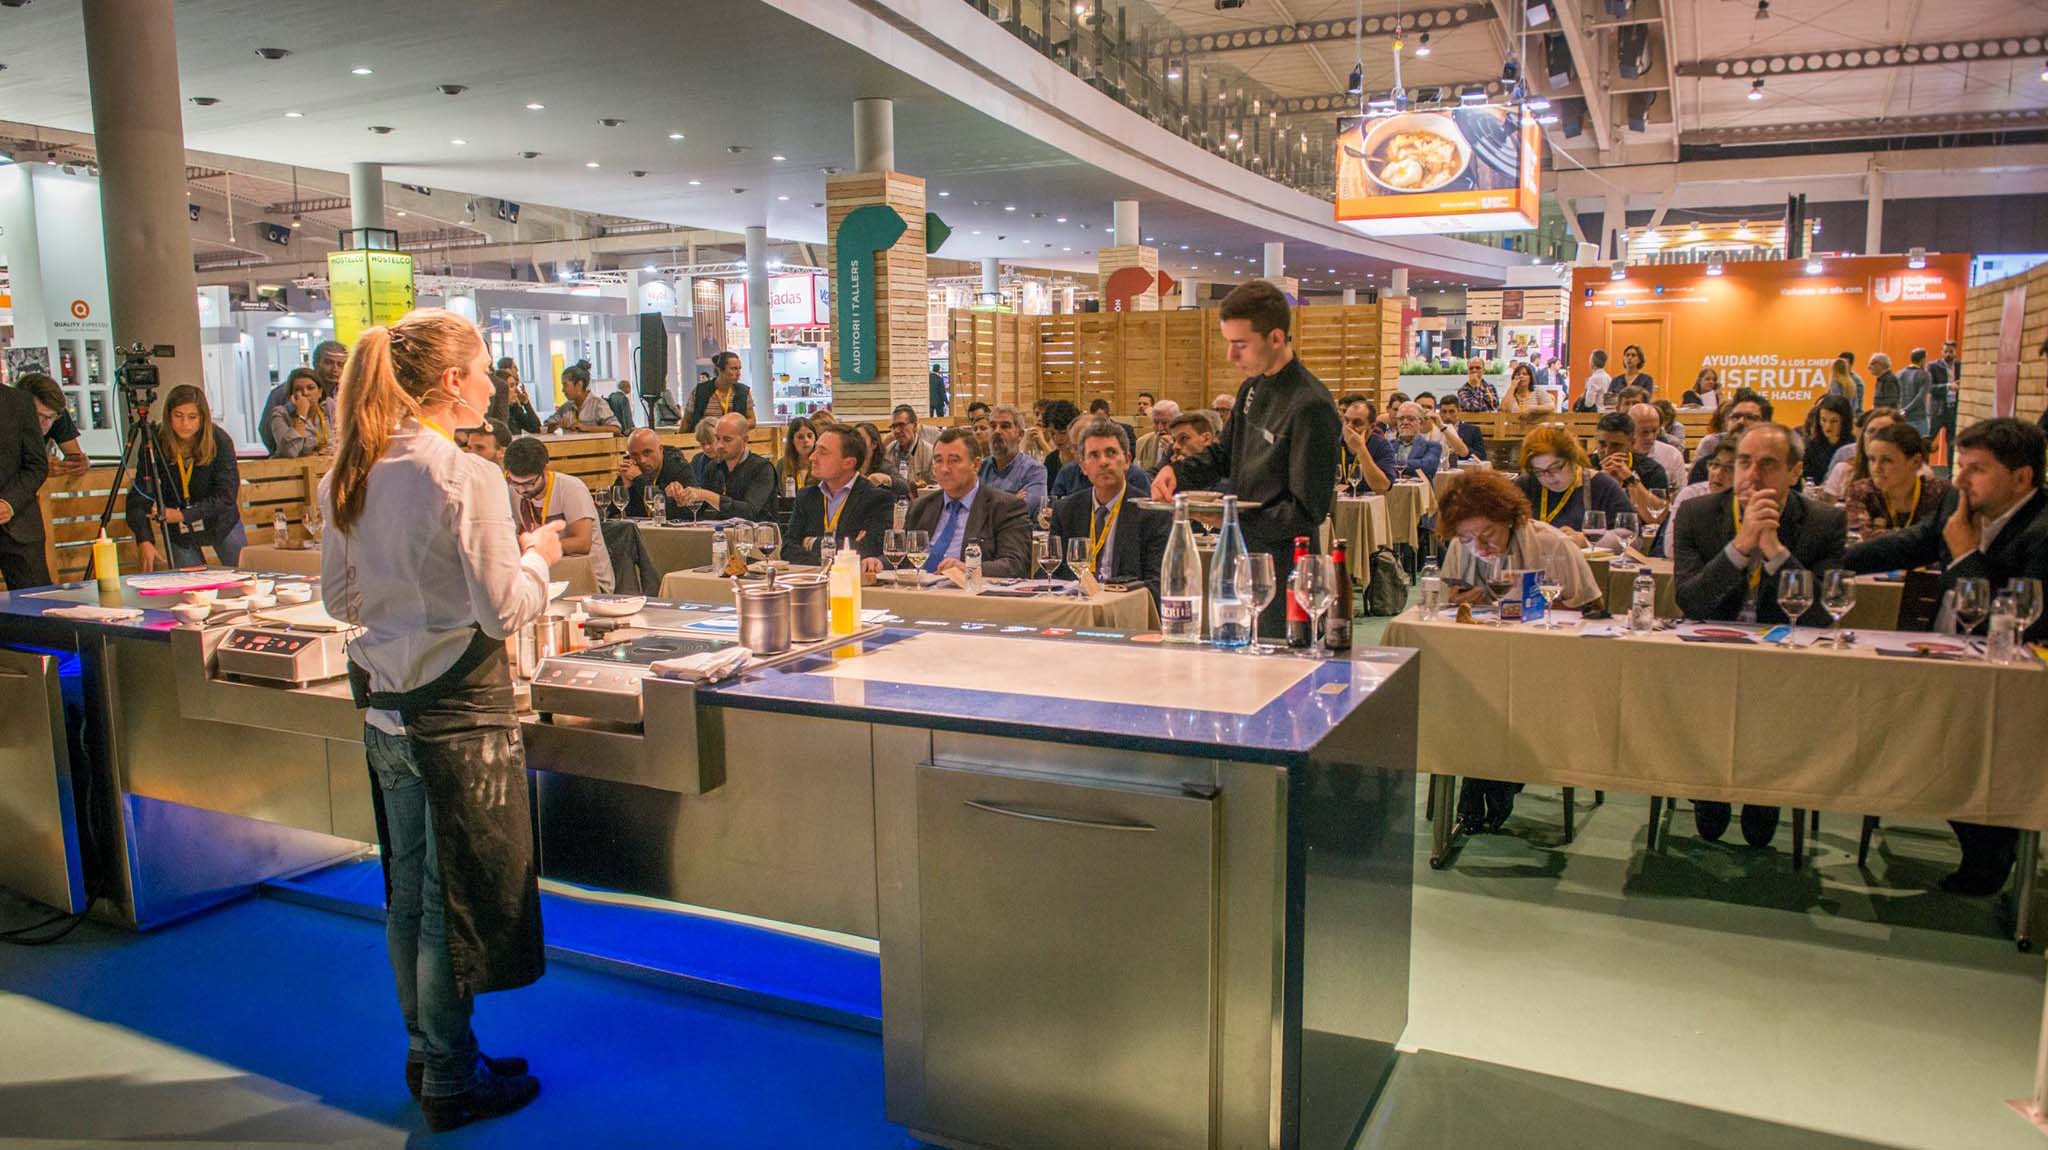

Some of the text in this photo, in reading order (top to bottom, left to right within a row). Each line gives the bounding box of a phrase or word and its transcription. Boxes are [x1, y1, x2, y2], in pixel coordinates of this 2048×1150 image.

[371, 256, 411, 265] HOSTELCO
[851, 259, 859, 309] TALLERS
[853, 320, 861, 374] AUDITORI
[1702, 354, 1778, 367] AYUDAMOS
[1788, 359, 1806, 367] LOS
[1719, 367, 1827, 389] ISFRUTA
[1771, 390, 1812, 401] HACEN
